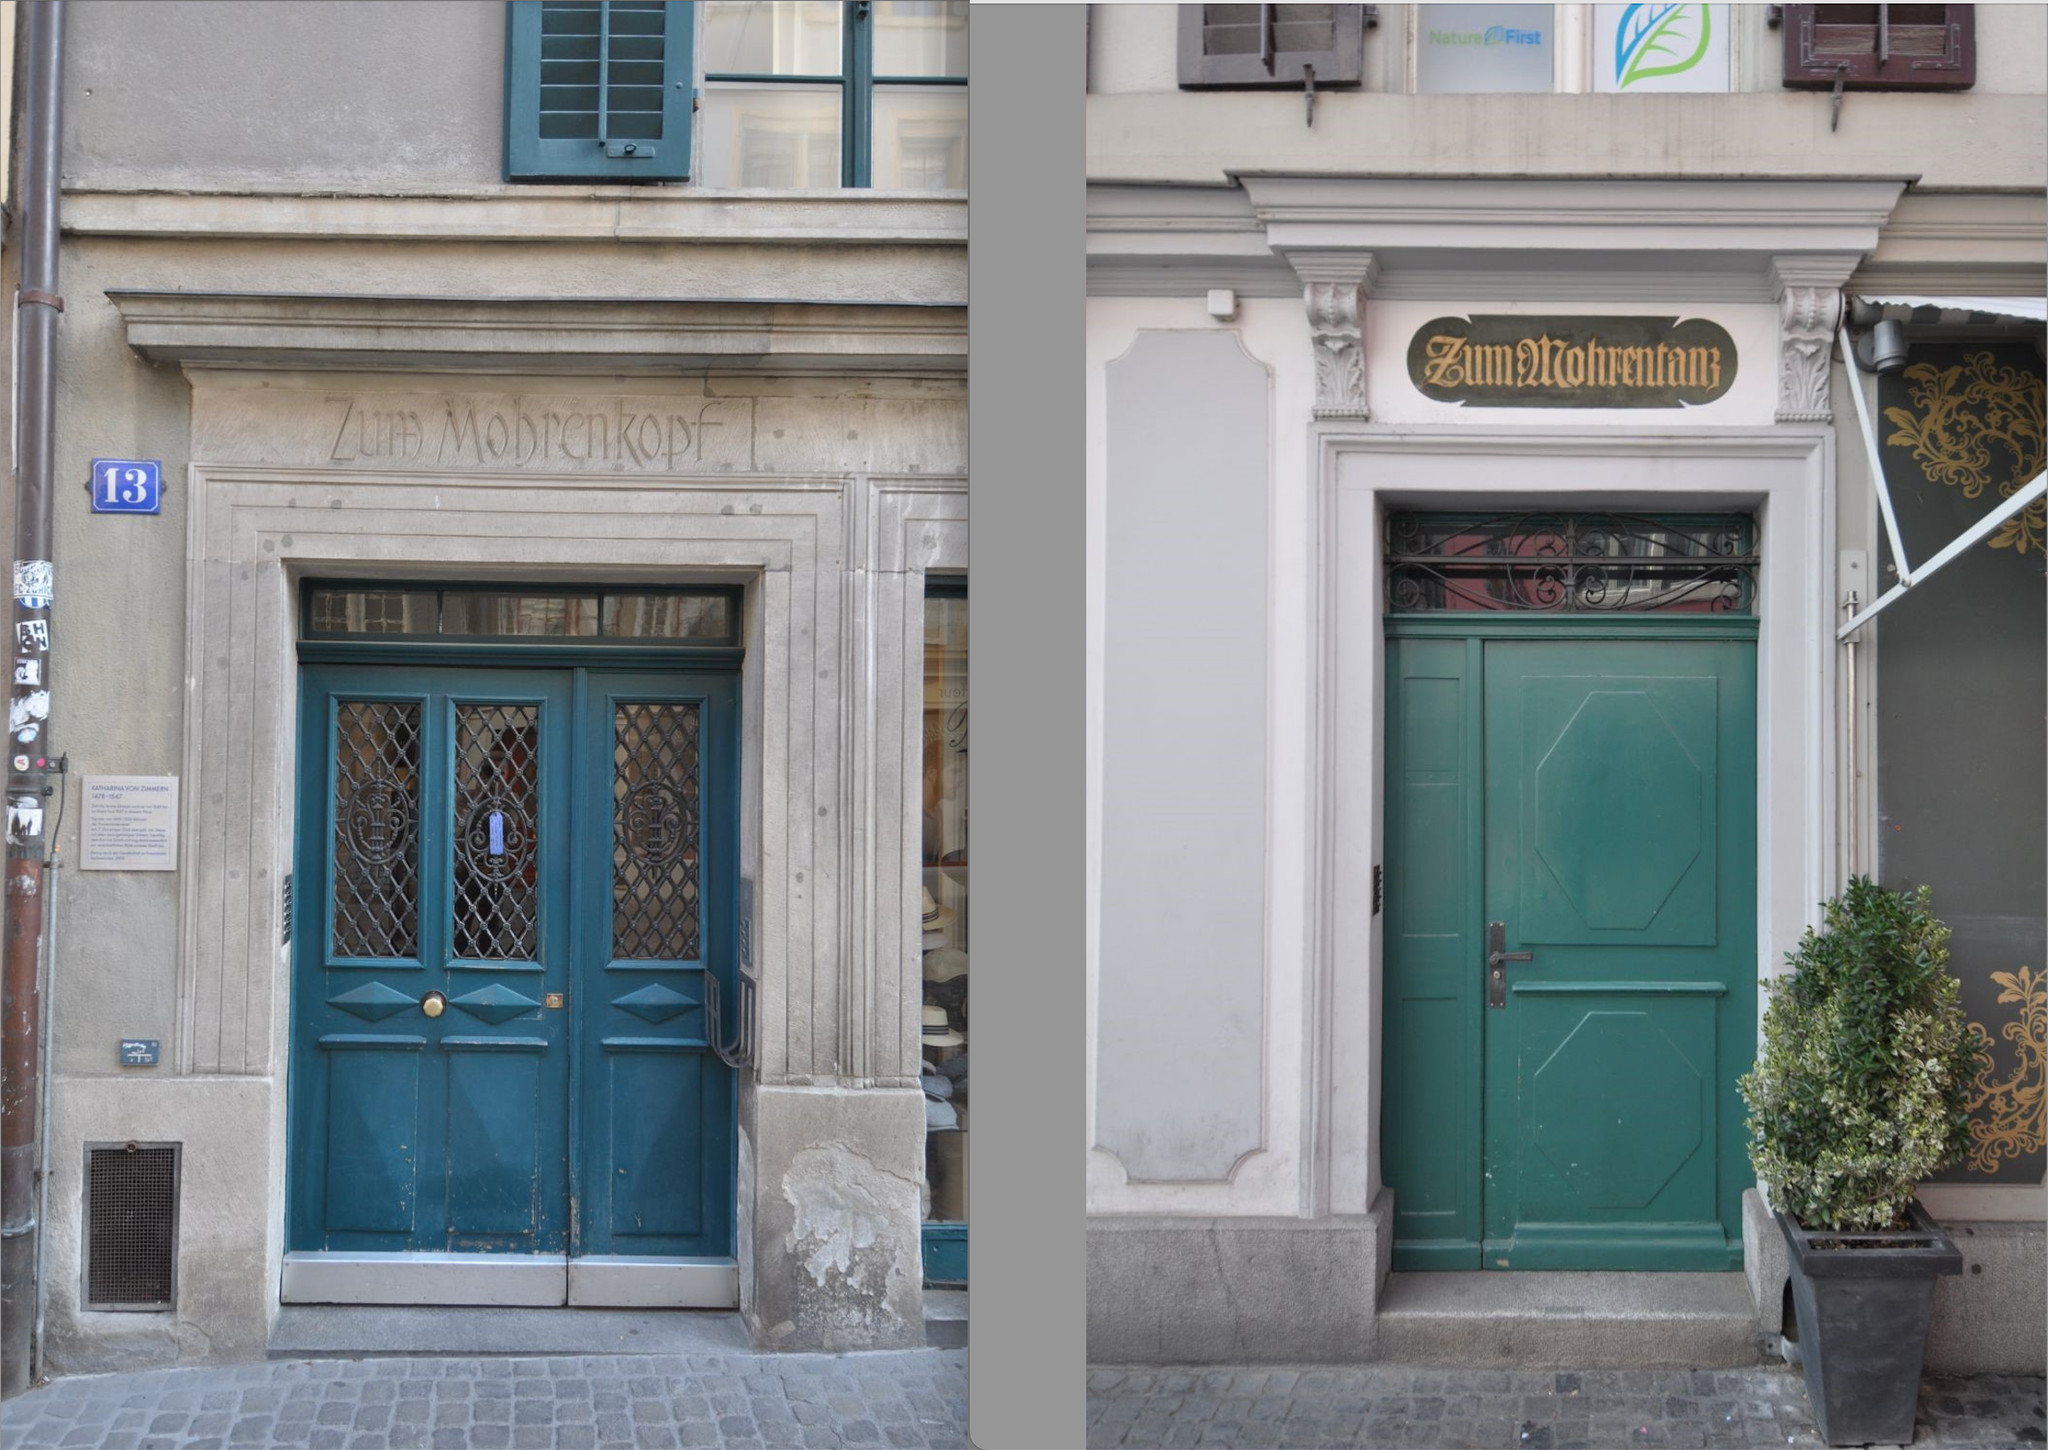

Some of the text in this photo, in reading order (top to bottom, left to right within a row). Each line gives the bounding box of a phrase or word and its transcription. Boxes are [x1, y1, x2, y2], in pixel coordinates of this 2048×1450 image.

[1428, 29, 1542, 46] Nature First
[1424, 333, 1721, 393] Zum Mohrentanz
[324, 395, 723, 471] Zum Mohrenkopf
[104, 468, 148, 503] 13
[140, 785, 169, 793] ZIMMERN
